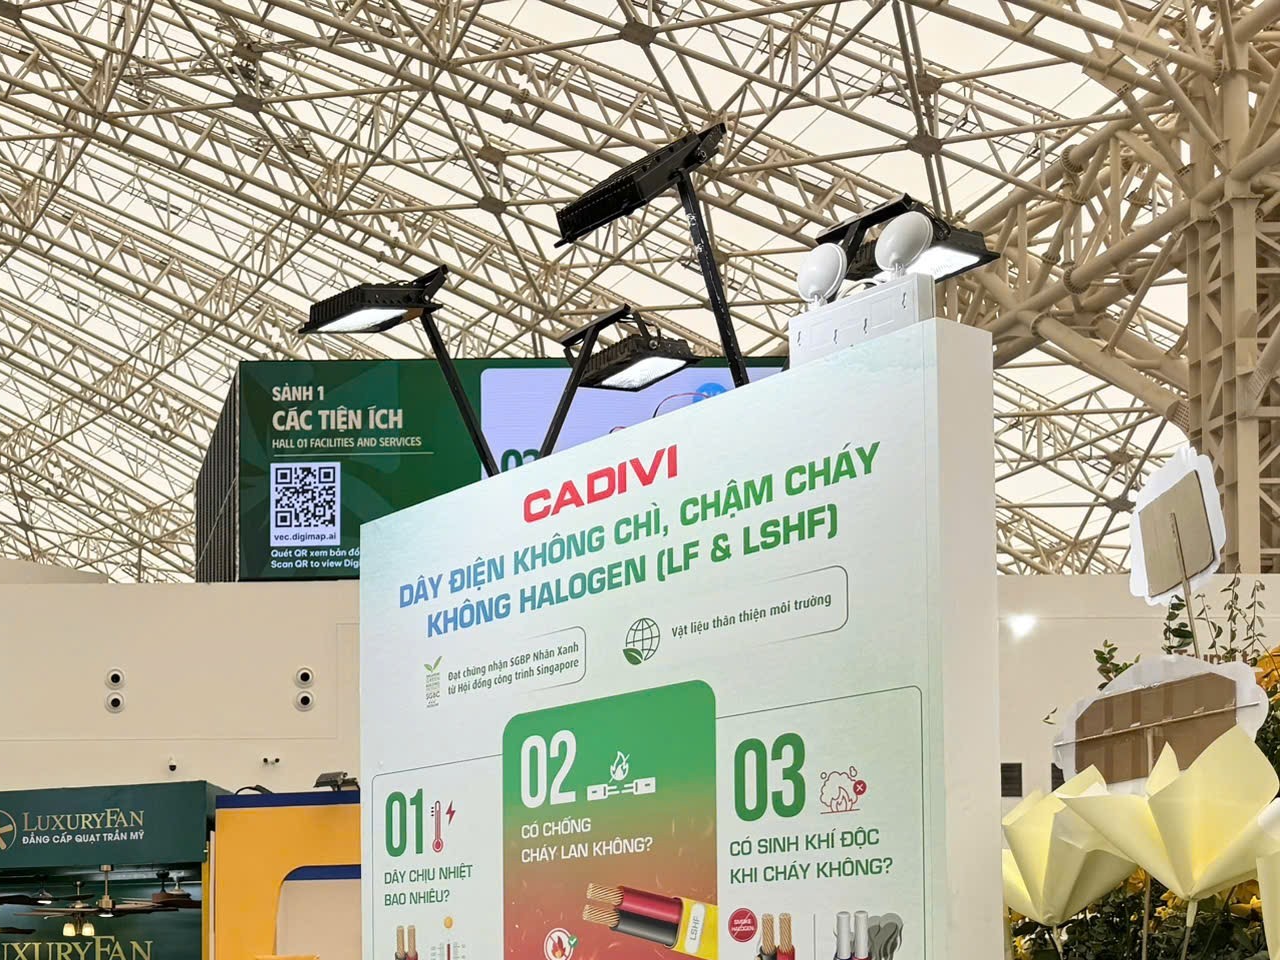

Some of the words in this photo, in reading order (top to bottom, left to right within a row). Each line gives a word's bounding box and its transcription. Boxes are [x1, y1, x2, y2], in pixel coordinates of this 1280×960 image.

[317, 385, 325, 401] 1
[272, 407, 313, 431] CÁC
[318, 405, 362, 432] TIỆN
[368, 405, 403, 430] ÍCH
[272, 438, 295, 449] HALL
[297, 438, 308, 448] 01
[310, 437, 355, 448] FACILITIES
[357, 437, 377, 448] AND
[379, 436, 422, 447] SERVICES
[523, 444, 677, 523] CADIVI
[274, 532, 336, 542] vec.digimap.ai
[400, 573, 443, 608] DÂY
[449, 555, 505, 593] ĐIỆN
[513, 525, 605, 575] KHÔNG
[614, 502, 668, 545] CHÌ,
[680, 474, 773, 526] CHẬM
[785, 441, 880, 496] CHÁY
[271, 548, 293, 558] Quét
[294, 548, 308, 558] QR
[310, 550, 328, 558] xem
[271, 559, 293, 568] Scan
[295, 559, 308, 568] QR
[310, 559, 320, 568] to
[321, 559, 342, 568] view
[427, 593, 511, 637] KHÔNG
[520, 555, 646, 613] HALOGEN
[657, 540, 699, 582] (LF
[711, 533, 732, 562] &
[743, 504, 837, 555] LSHF)
[672, 625, 687, 638] Vật
[691, 620, 709, 635] liệu
[712, 614, 735, 629] thân
[739, 607, 766, 623] thiện
[770, 600, 791, 616] môi
[794, 594, 832, 611] trường
[510, 654, 530, 667] SGBP
[557, 641, 579, 657] Xanh
[536, 659, 579, 675] Singapore
[520, 730, 577, 809] 02
[734, 732, 806, 822] 03
[385, 788, 424, 857] 01
[521, 822, 539, 839] CÓ
[543, 816, 591, 837] CHỐNG
[22, 831, 51, 844] ĐẲNG
[52, 831, 73, 844] CẤP
[75, 831, 102, 844] QUẠT
[103, 828, 129, 842] TRẦN
[130, 829, 145, 841] MỸ
[730, 835, 751, 856] CÓ
[757, 835, 799, 854] SINH
[805, 828, 836, 850] KHÍ
[840, 826, 880, 849] ĐỘC
[521, 845, 558, 863] CHÁY
[561, 842, 589, 860] LAN
[592, 836, 654, 857] KHÔNG?
[384, 868, 406, 885] DÂY
[409, 868, 435, 884] CHỊU
[439, 862, 473, 880] NHIỆT
[730, 867, 758, 885] KHI
[763, 860, 810, 882] CHÁY
[816, 857, 893, 879] KHÔNG?
[384, 891, 406, 907] BAO
[409, 888, 450, 905] NHIÊU?
[689, 916, 701, 941] LSHF
